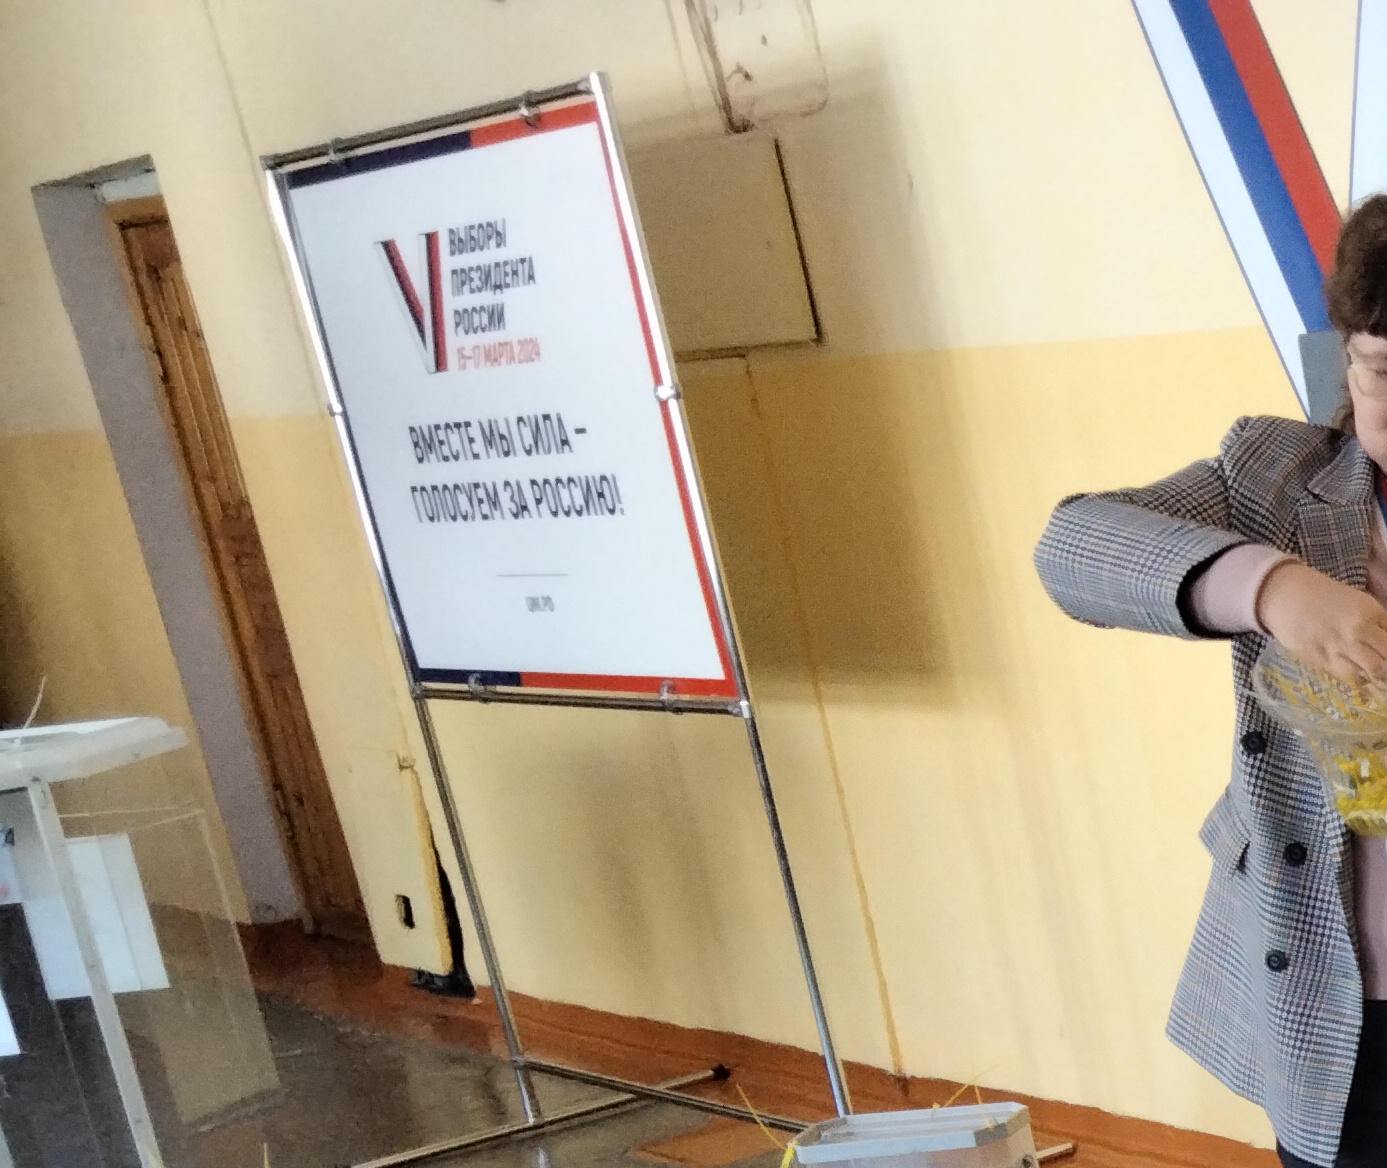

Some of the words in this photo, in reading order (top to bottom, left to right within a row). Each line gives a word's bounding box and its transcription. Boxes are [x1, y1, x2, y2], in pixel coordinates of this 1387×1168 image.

[448, 218, 507, 257] ВЫБОРЫ
[451, 256, 536, 296] ПРЕЗИДЕНТА
[453, 302, 507, 336] РОССИИ
[483, 340, 516, 367] МАРТА
[408, 421, 480, 464] ВМЕСТЕ
[478, 417, 517, 459] МЫ
[516, 412, 574, 456] СИЛА
[410, 480, 505, 523] ГОЛОСУЕМ
[503, 479, 533, 520] ЗА
[529, 473, 625, 519] РОССИЮ!
